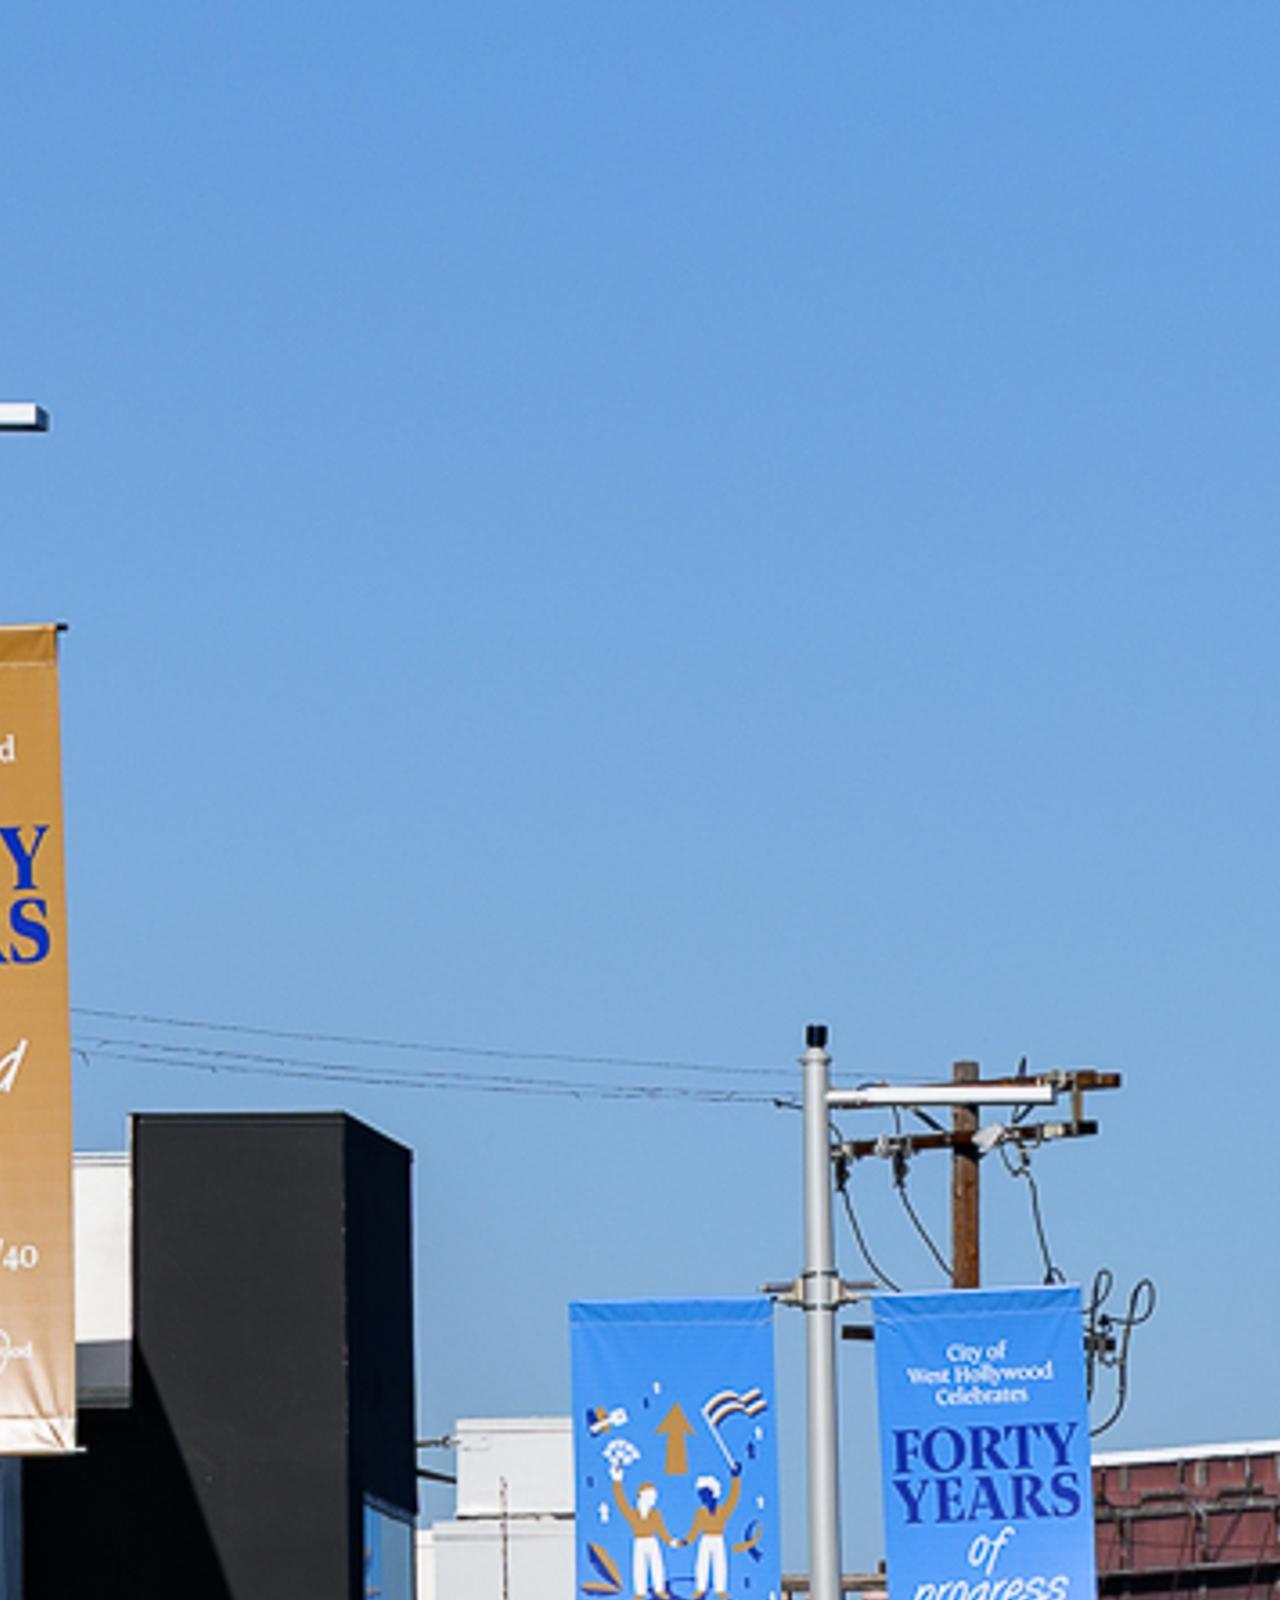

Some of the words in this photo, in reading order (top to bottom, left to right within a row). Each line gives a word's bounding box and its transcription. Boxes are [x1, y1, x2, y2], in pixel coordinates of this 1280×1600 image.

[946, 1344, 982, 1365] City
[986, 1339, 1007, 1360] of
[906, 1368, 950, 1384] West
[955, 1360, 1053, 1386] Hollywood
[935, 1386, 1029, 1405] Celebrates
[892, 1423, 1079, 1474] FORTY
[892, 1472, 1081, 1524] YEARS
[968, 1526, 1015, 1576] of
